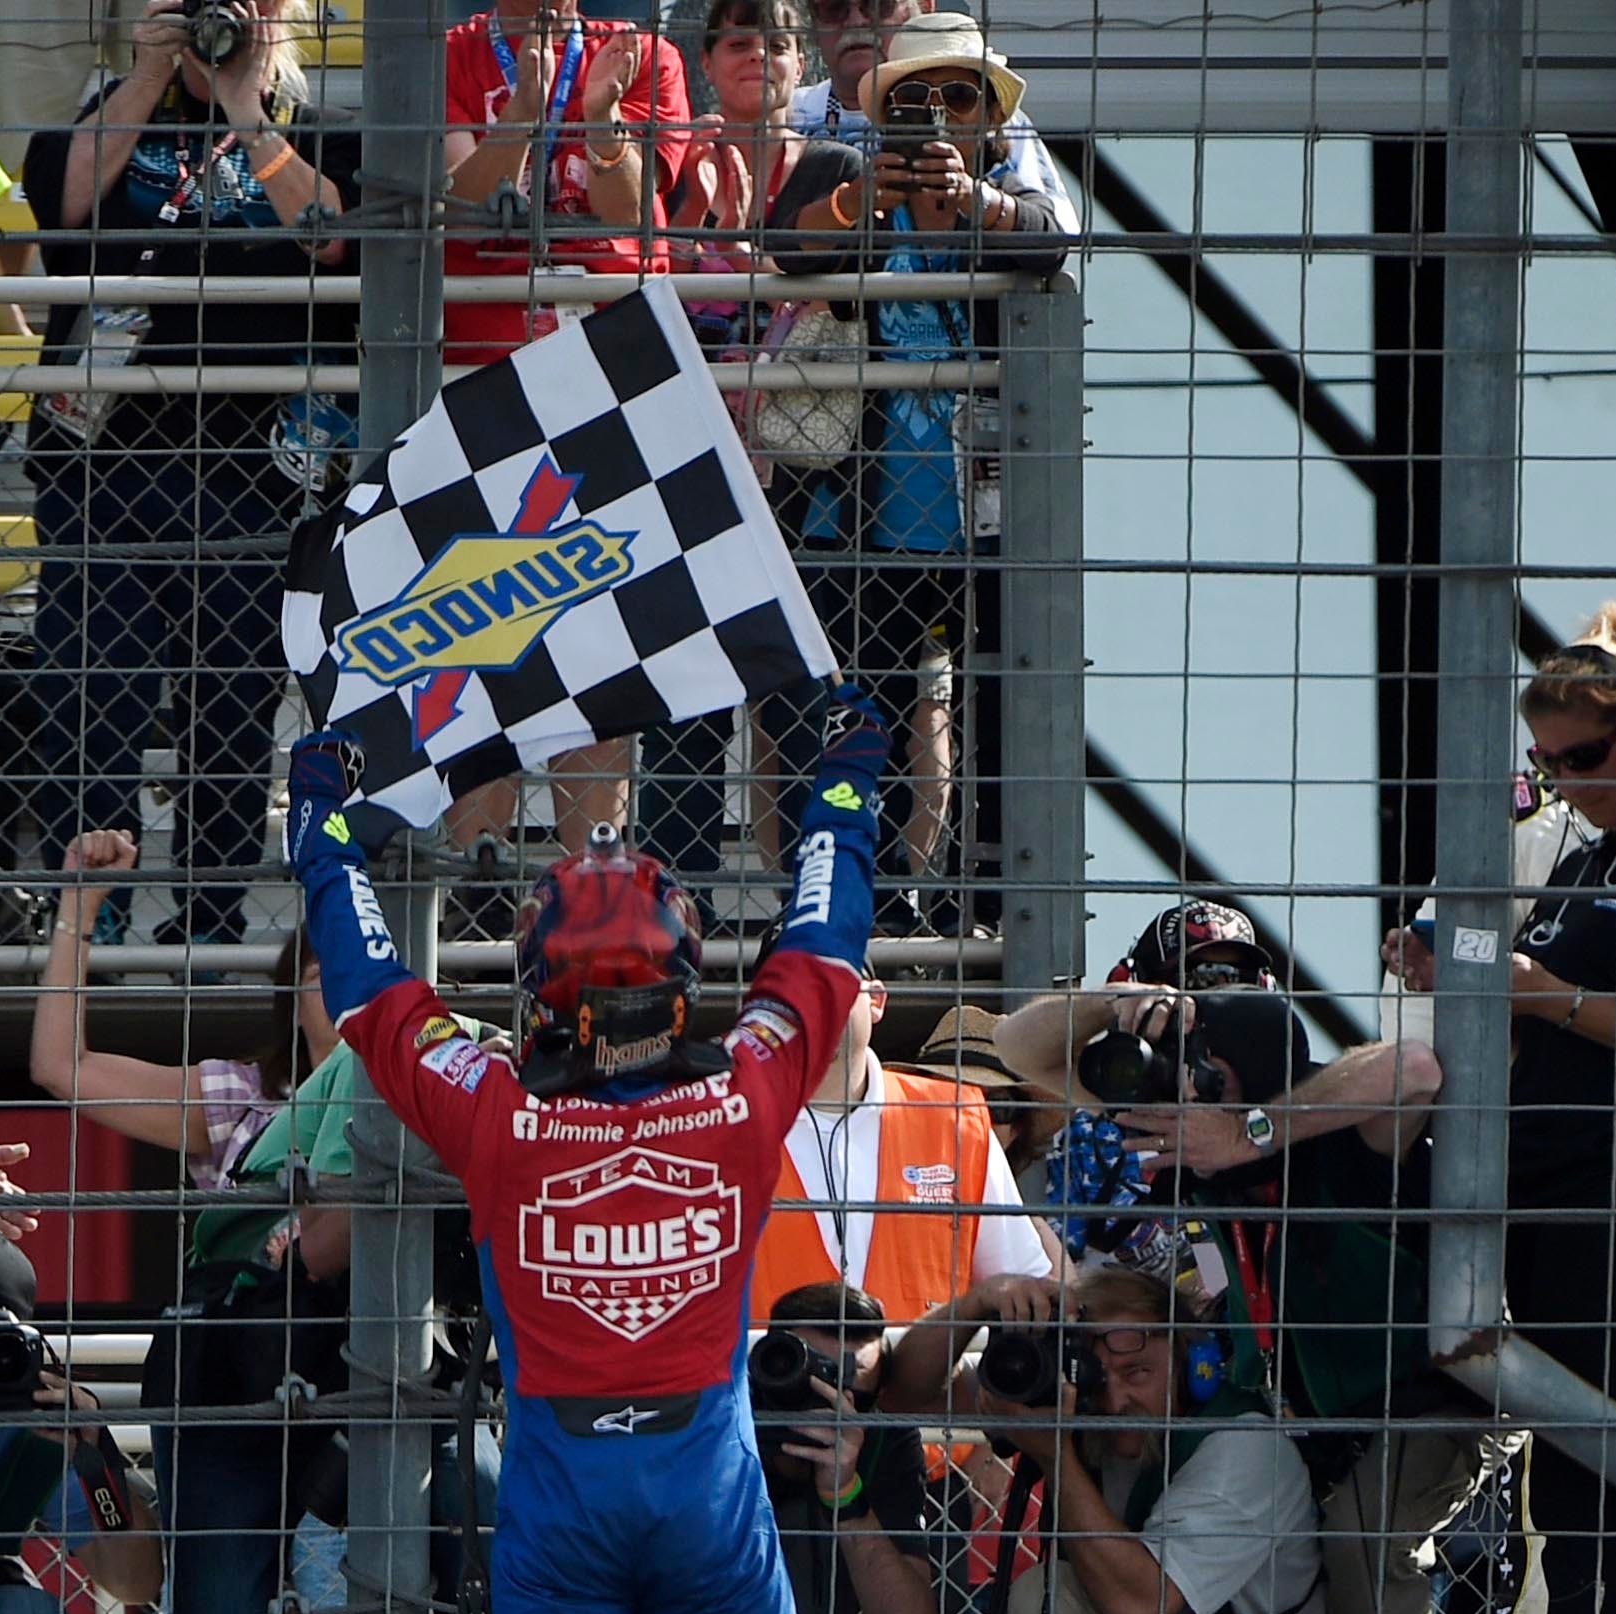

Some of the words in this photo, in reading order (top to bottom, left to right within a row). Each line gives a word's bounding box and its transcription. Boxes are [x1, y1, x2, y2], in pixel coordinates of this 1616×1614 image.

[1458, 930, 1495, 959] 20
[595, 1030, 672, 1077] hans
[541, 1118, 625, 1143] Jimmie
[631, 1107, 725, 1141] Johnson
[569, 1156, 692, 1195] TEAM
[543, 1205, 721, 1266] LOWE'S
[552, 1266, 709, 1297] RACING
[94, 1486, 123, 1529] EOS
